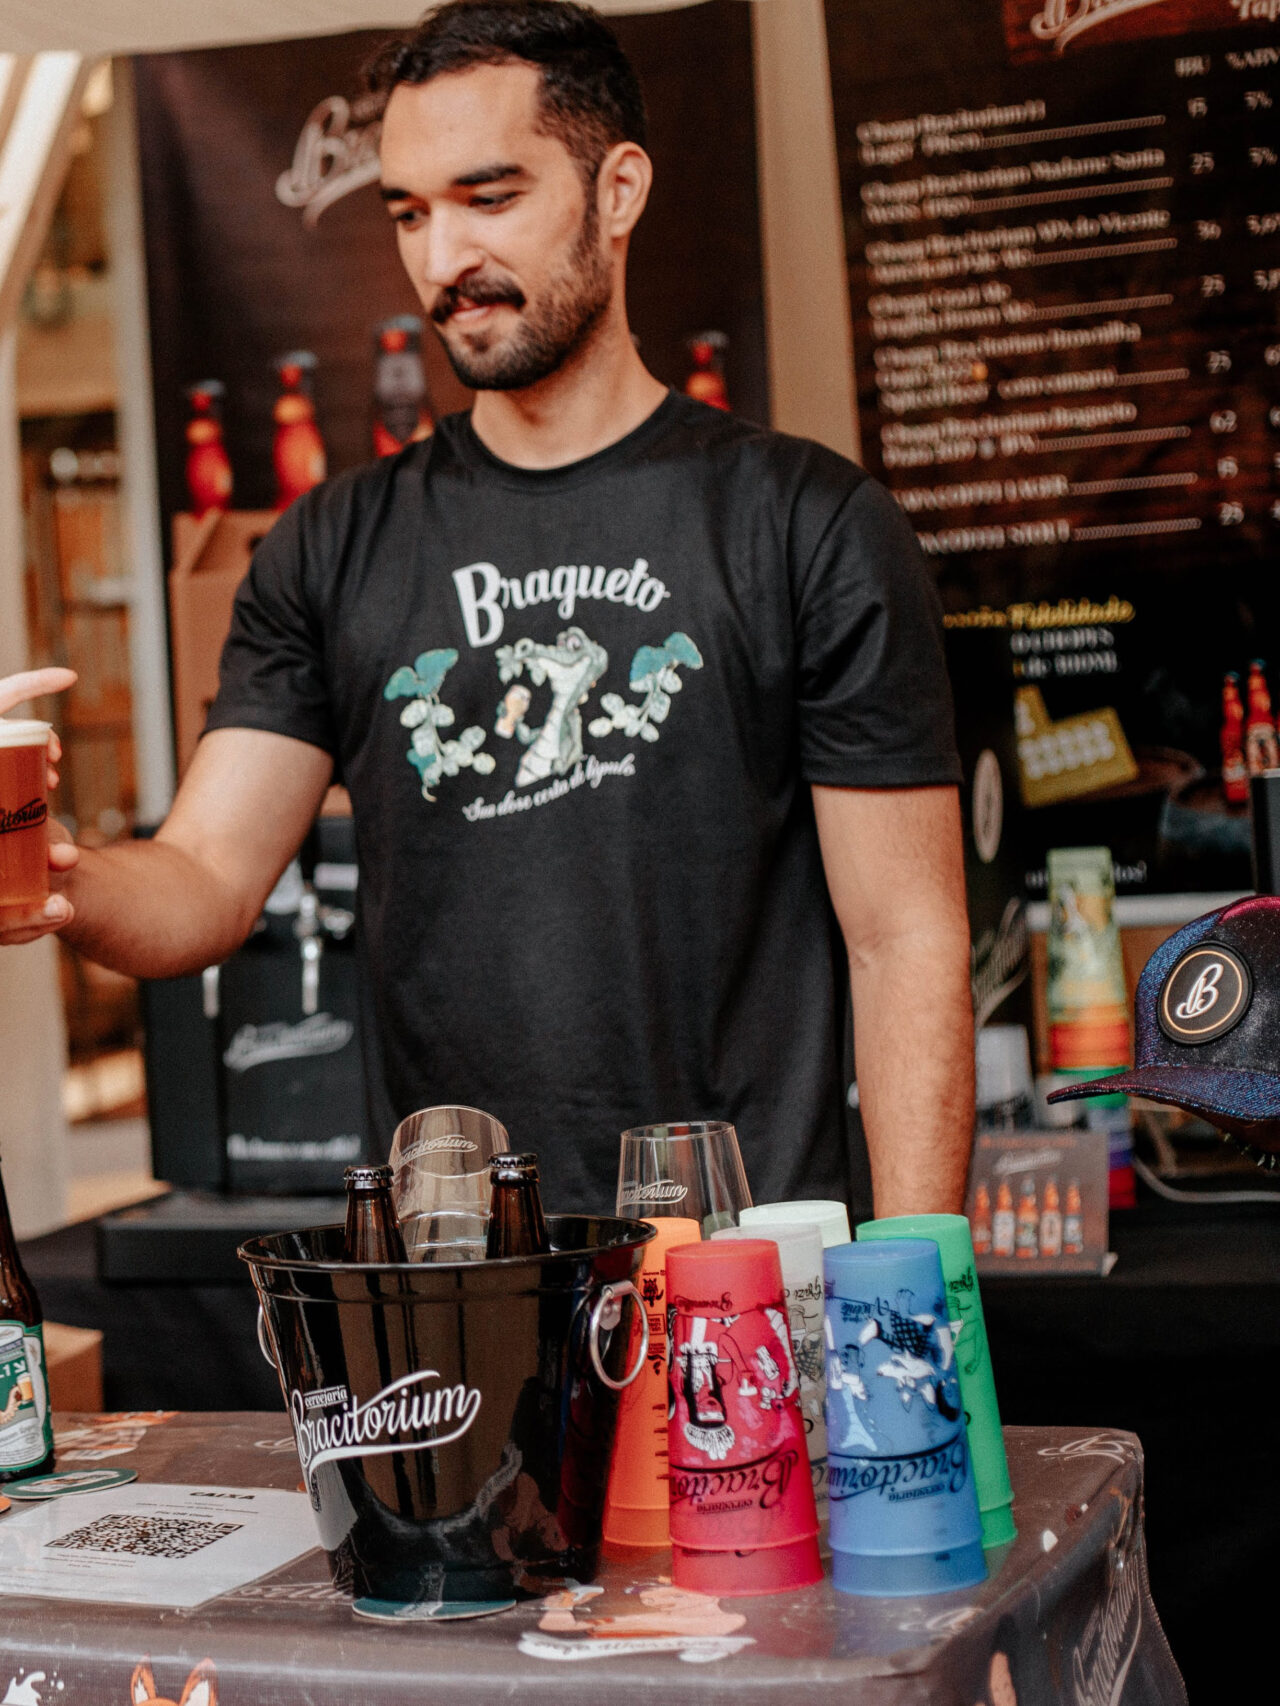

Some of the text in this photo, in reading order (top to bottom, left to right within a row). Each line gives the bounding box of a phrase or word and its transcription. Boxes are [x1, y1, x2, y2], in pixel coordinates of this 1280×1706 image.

[451, 557, 671, 649] Bragueto
[291, 1370, 482, 1482] Bracitorium
[304, 1385, 348, 1409] cervejaria
[189, 1491, 256, 1501] CAIXA
